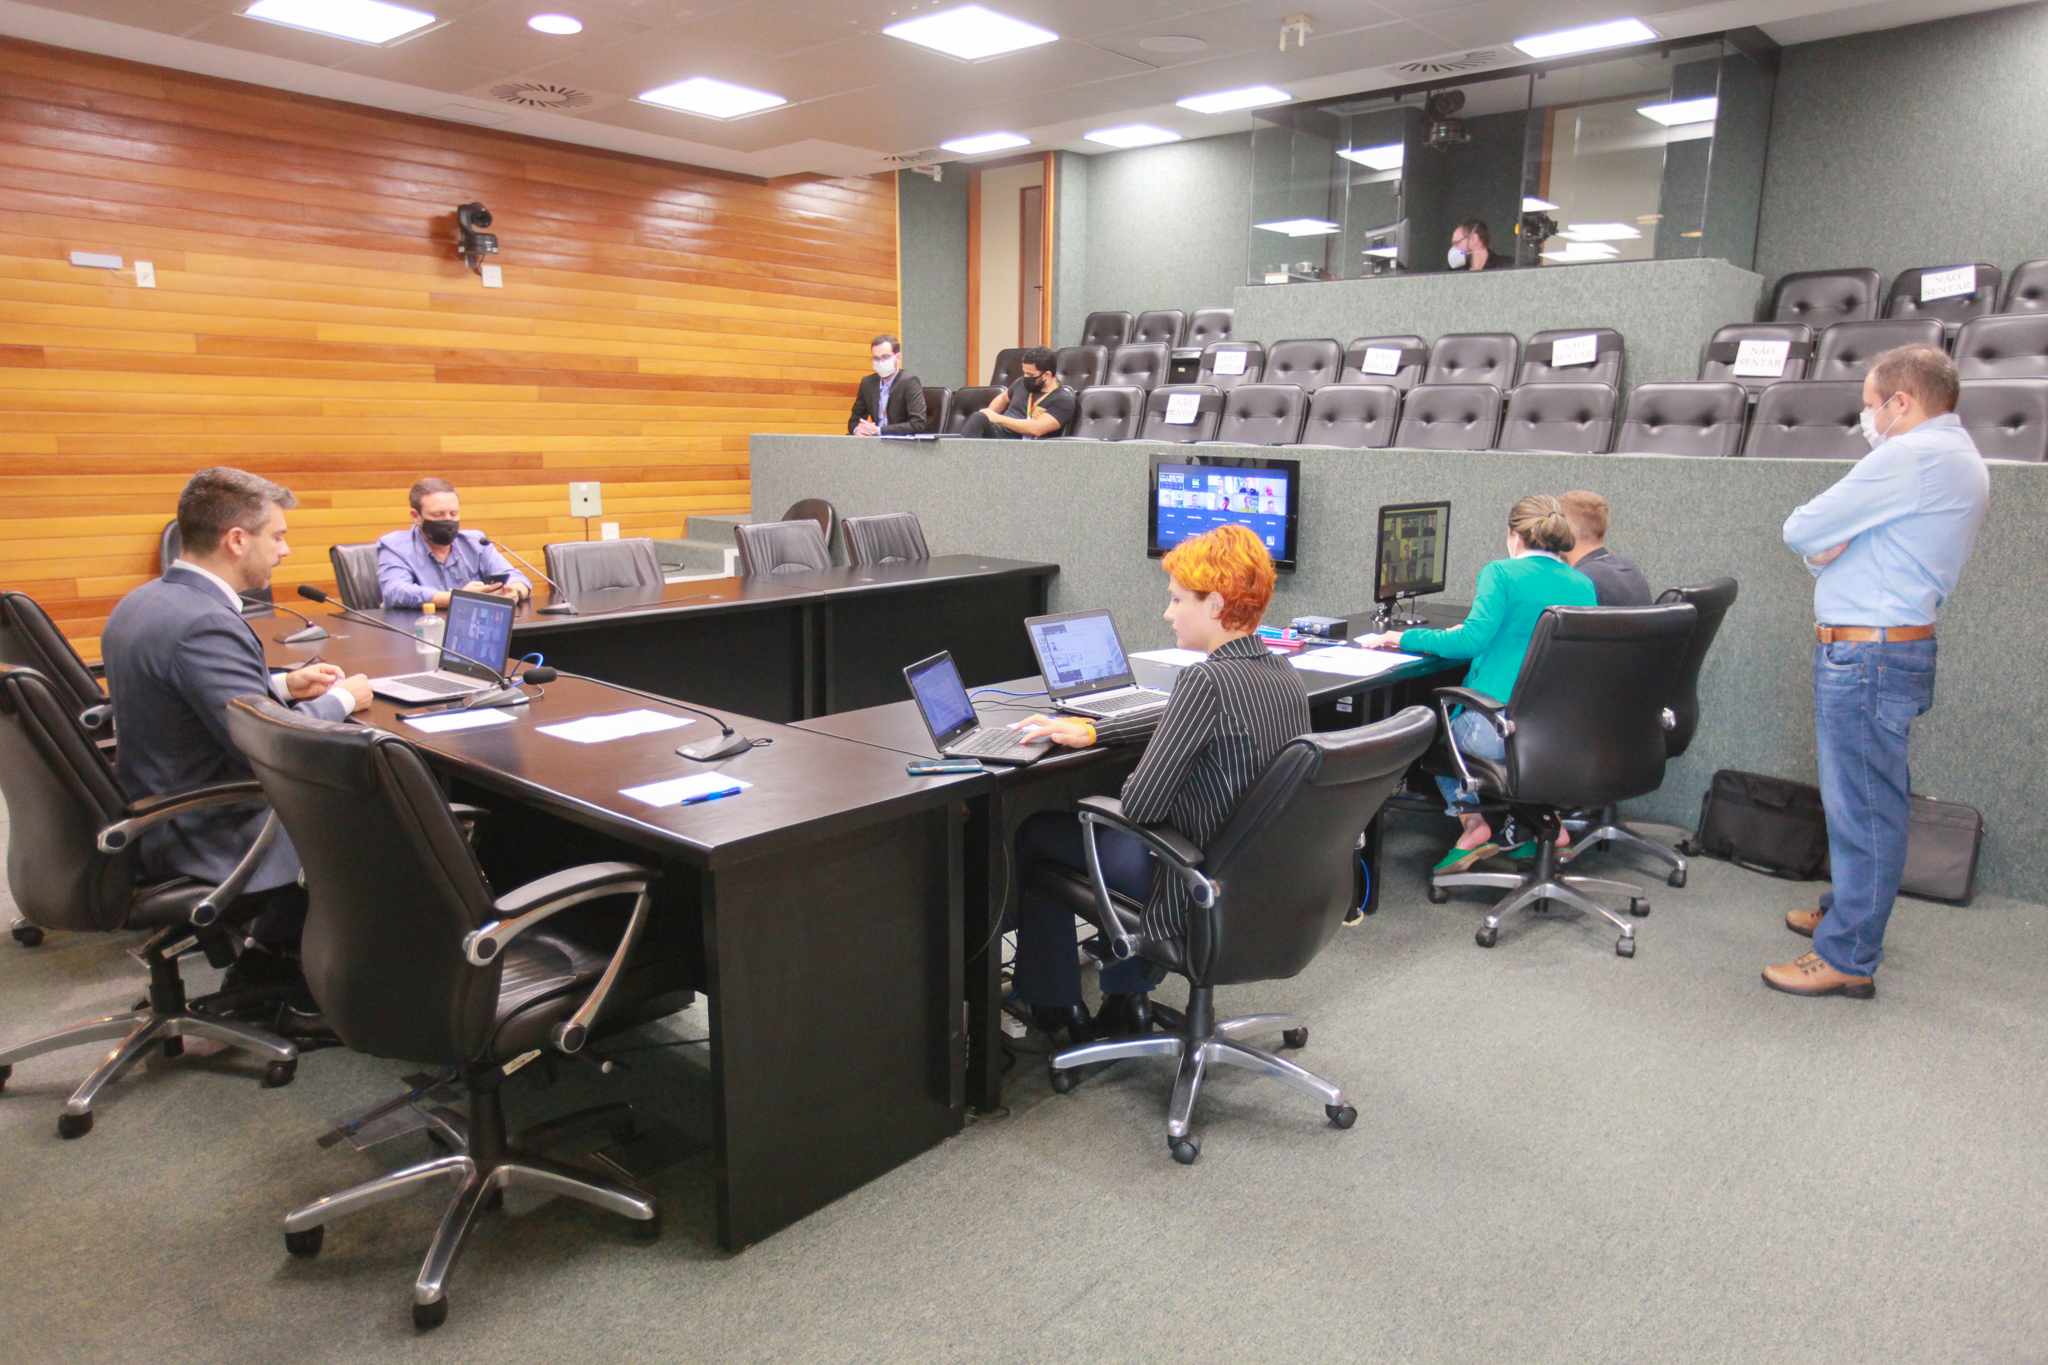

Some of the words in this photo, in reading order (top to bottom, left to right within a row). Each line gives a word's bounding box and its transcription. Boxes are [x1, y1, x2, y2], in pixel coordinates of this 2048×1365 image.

[1934, 273, 1961, 284] NÃO
[1924, 282, 1971, 296] SENTAR
[1750, 345, 1775, 356] NÃO
[1737, 358, 1781, 368] SENTAR
